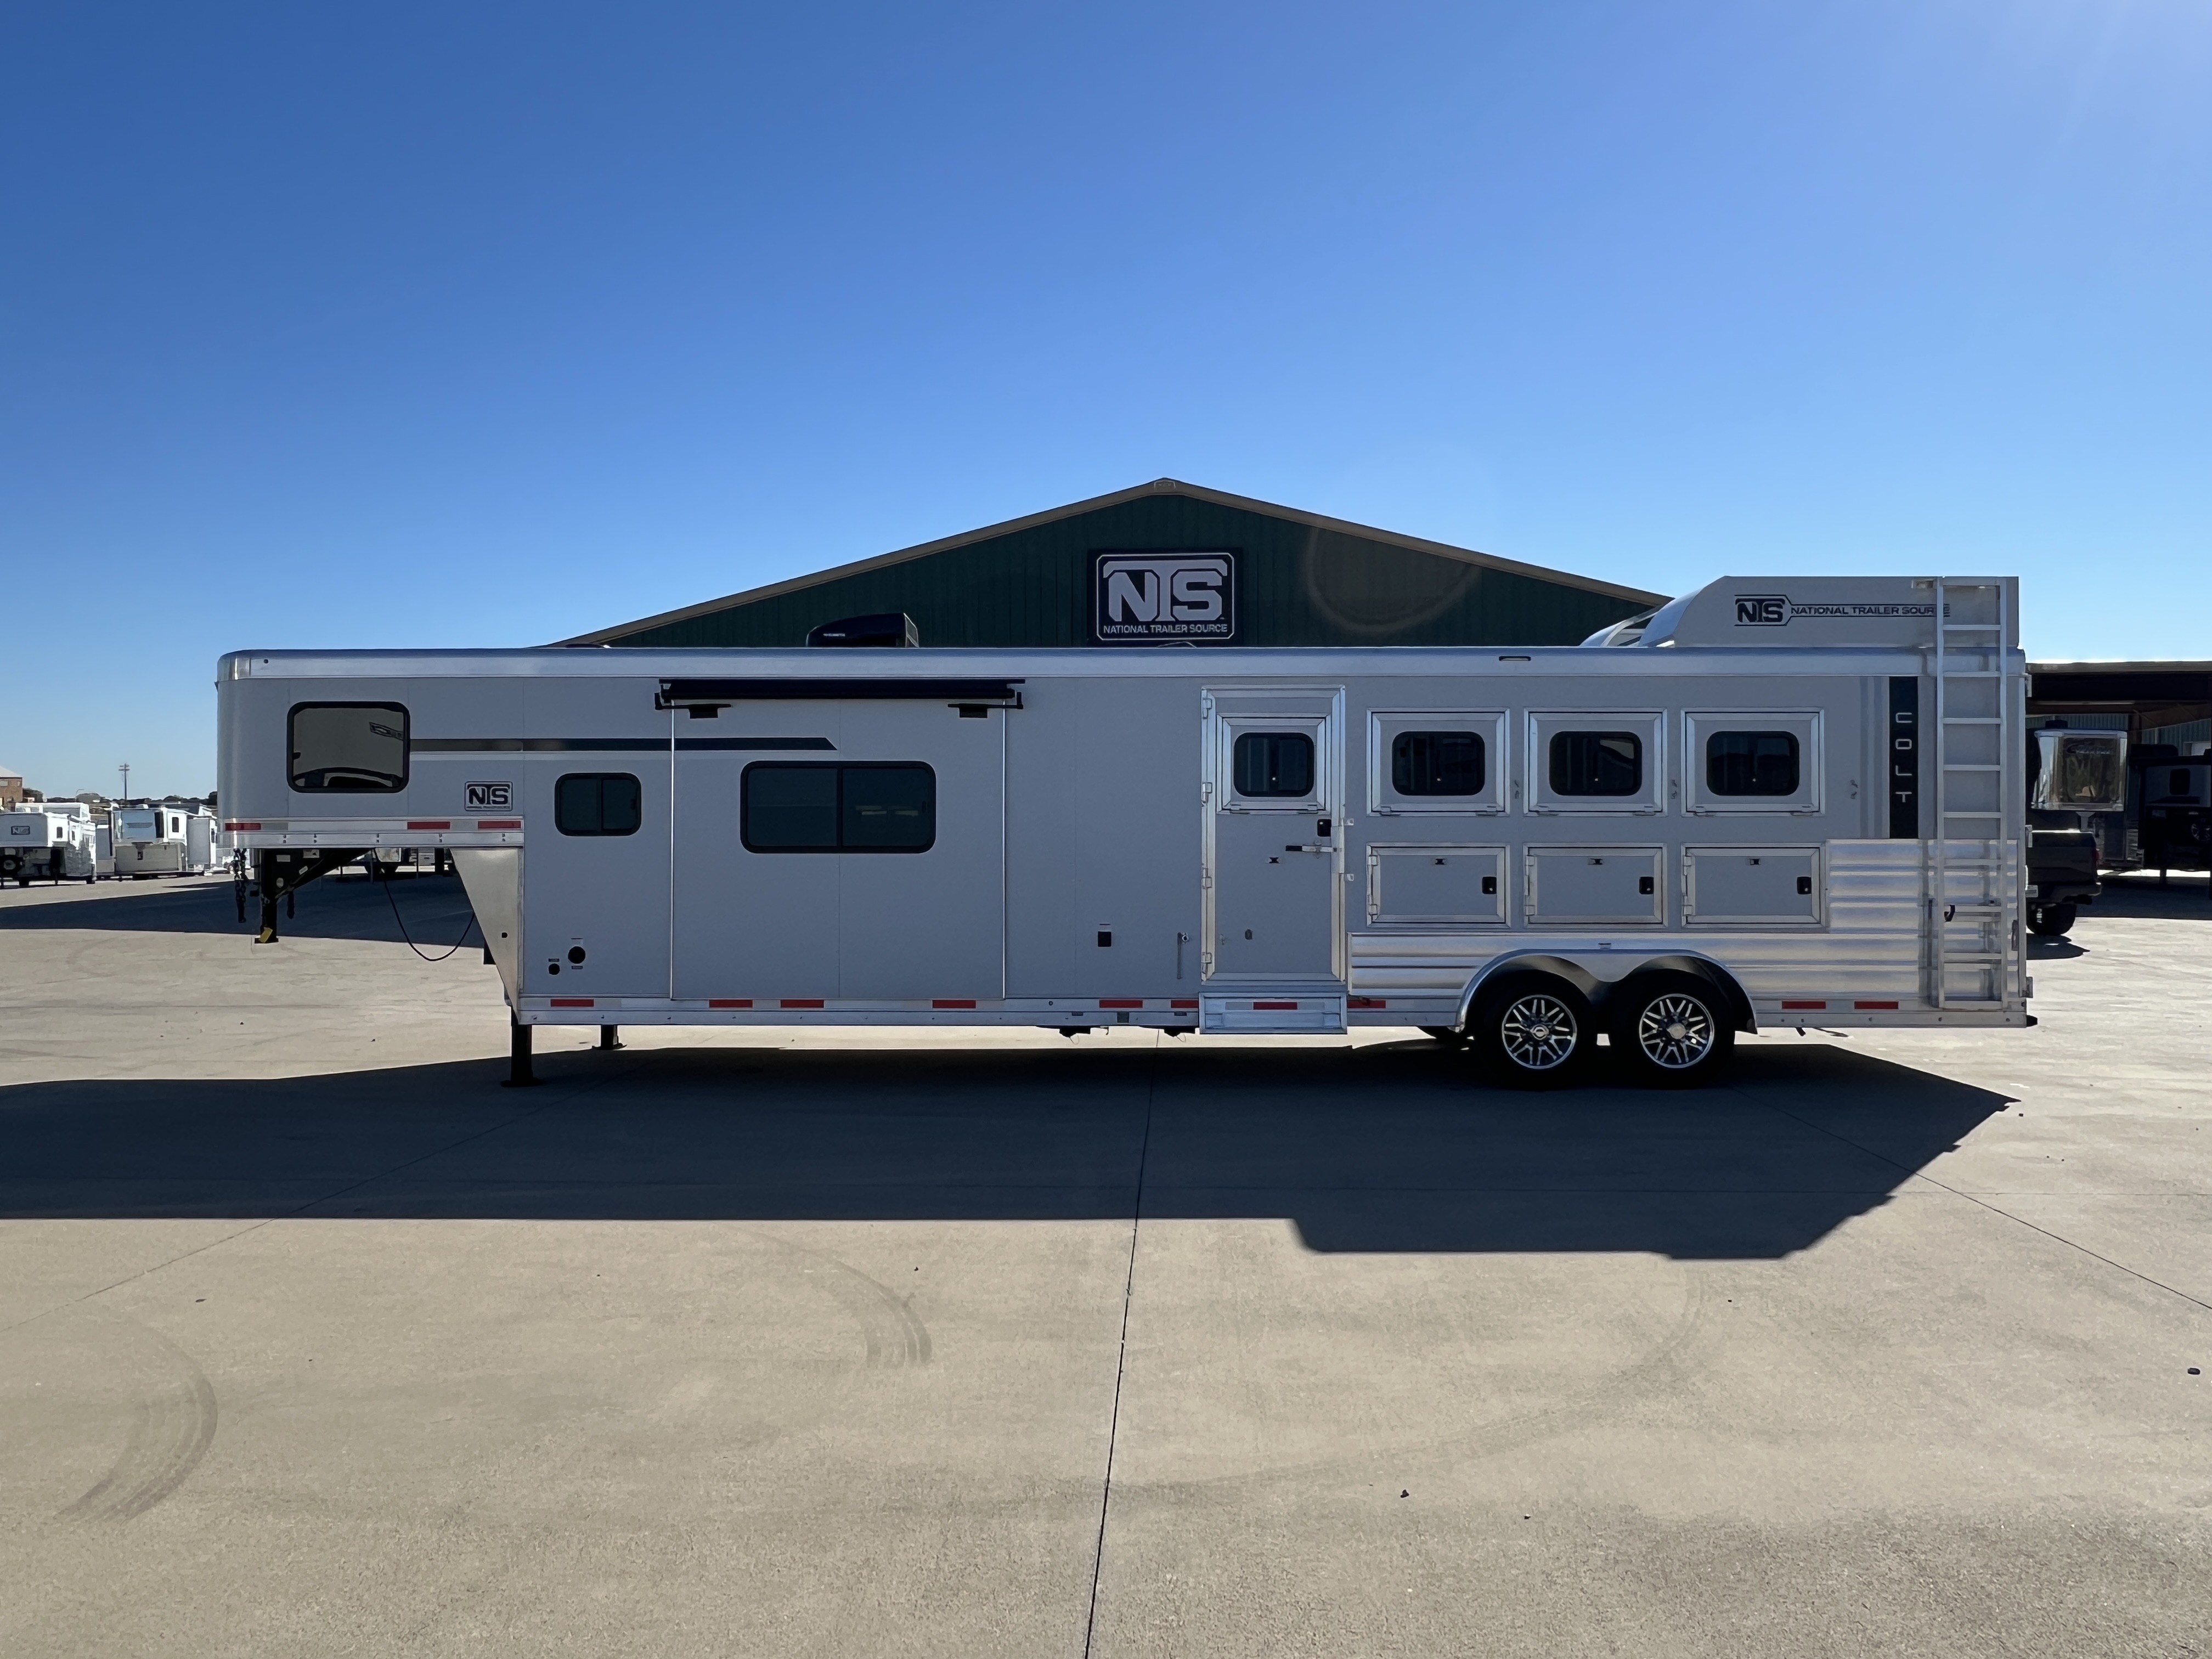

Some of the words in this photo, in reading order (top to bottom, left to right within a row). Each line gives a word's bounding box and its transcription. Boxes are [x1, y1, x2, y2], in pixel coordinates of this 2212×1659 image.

[1103, 559, 1228, 622] NTS
[1735, 598, 1785, 623] NTS
[1103, 625, 1149, 633] NATIONAL
[1189, 624, 1228, 632] SOURCE
[1895, 712, 1912, 803] COLT
[467, 783, 510, 805] NTS
